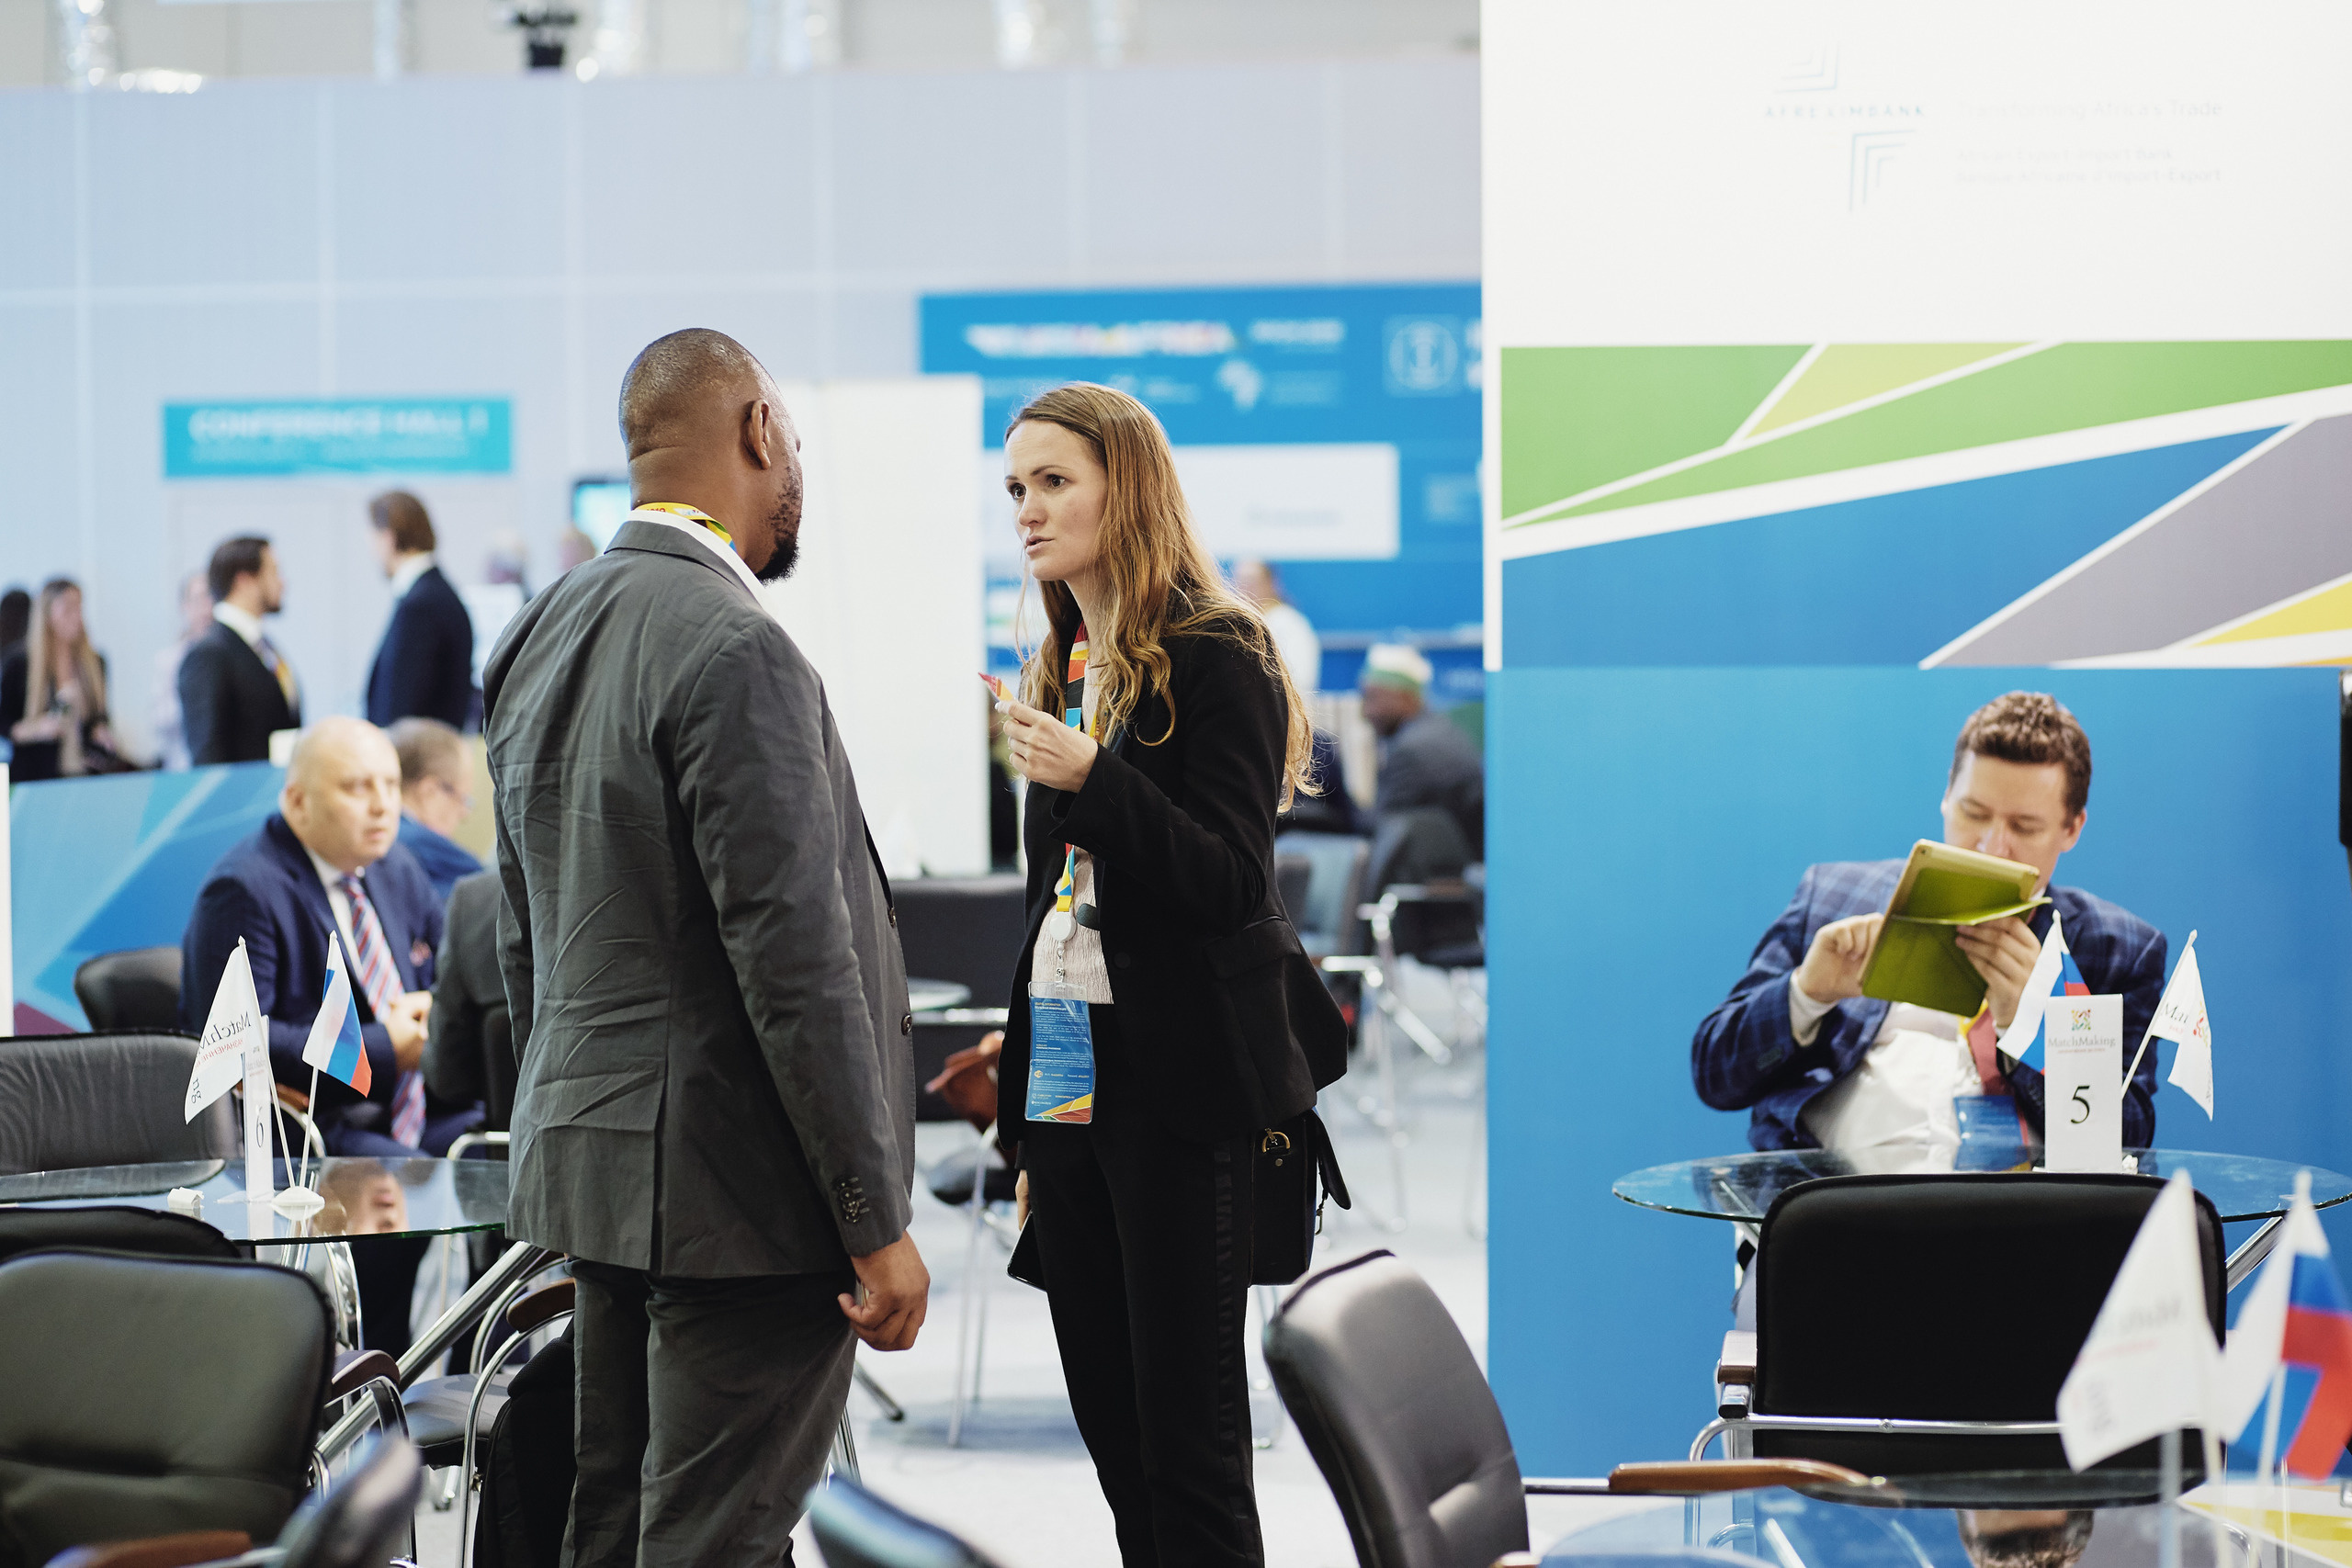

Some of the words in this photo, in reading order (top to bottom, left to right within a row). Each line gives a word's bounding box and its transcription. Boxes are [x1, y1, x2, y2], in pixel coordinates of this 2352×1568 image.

[2169, 98, 2222, 117] Trade
[2048, 1034, 2117, 1049] MatchMaking
[2070, 1085, 2090, 1124] 5
[255, 1105, 265, 1148] 6
